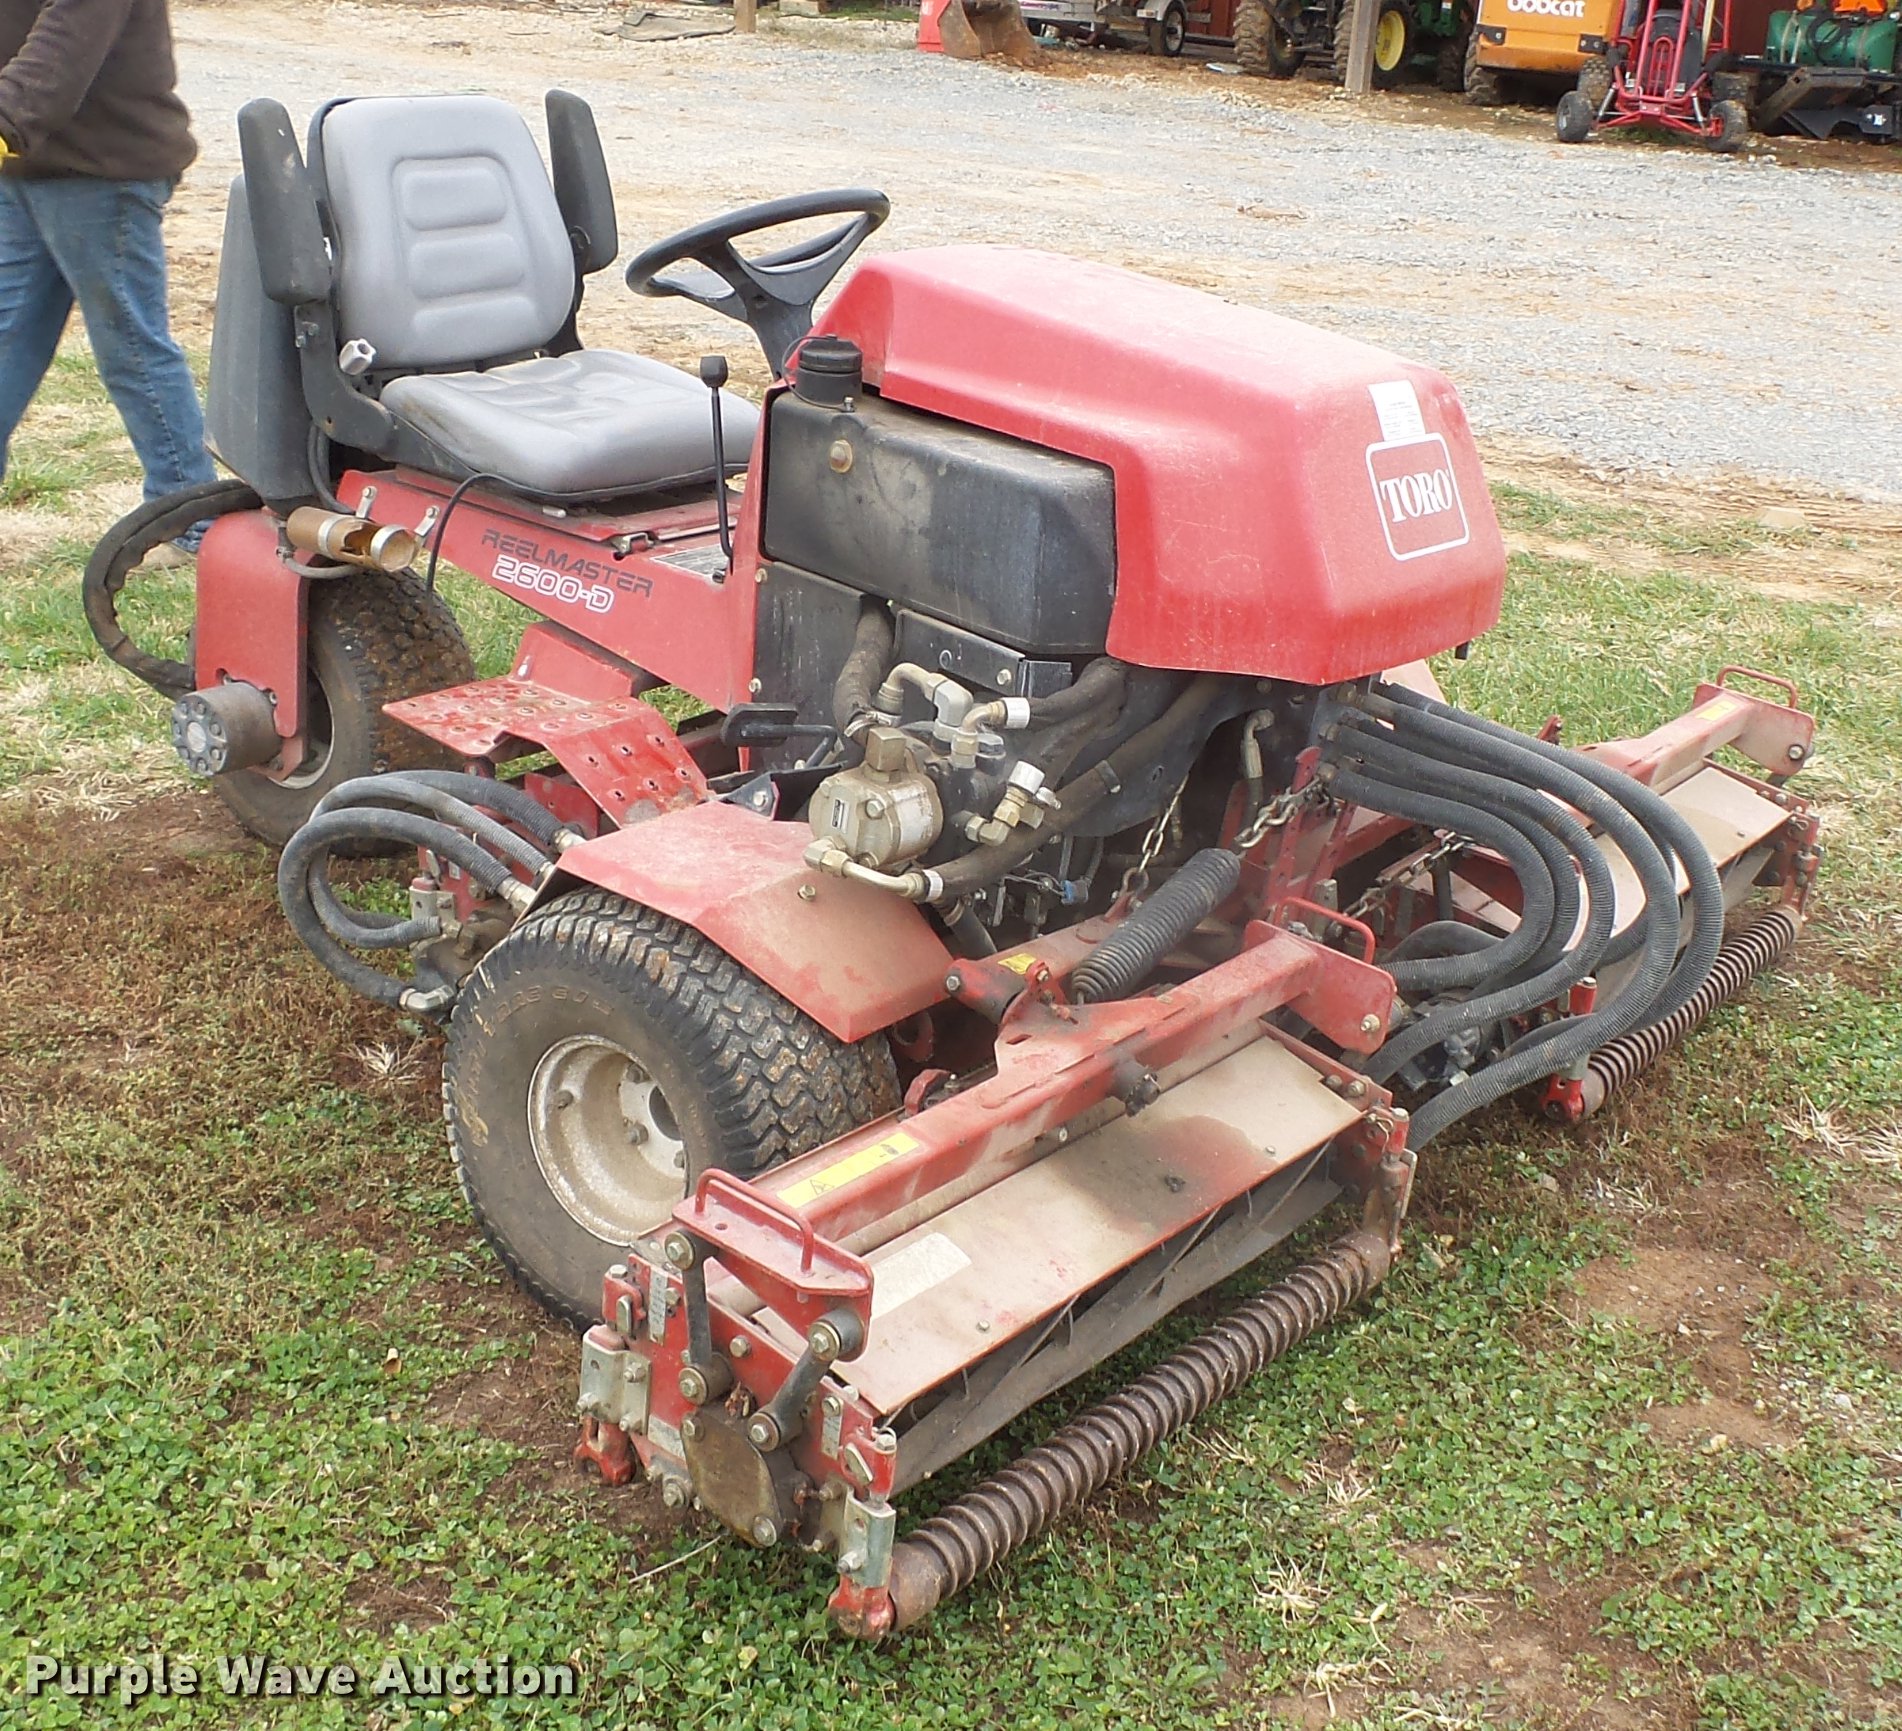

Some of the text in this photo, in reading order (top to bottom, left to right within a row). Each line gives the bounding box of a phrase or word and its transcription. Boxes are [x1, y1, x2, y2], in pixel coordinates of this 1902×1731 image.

[1379, 468, 1453, 523] TORO
[481, 528, 654, 598] REELMASTER
[491, 553, 615, 613] 2600-D
